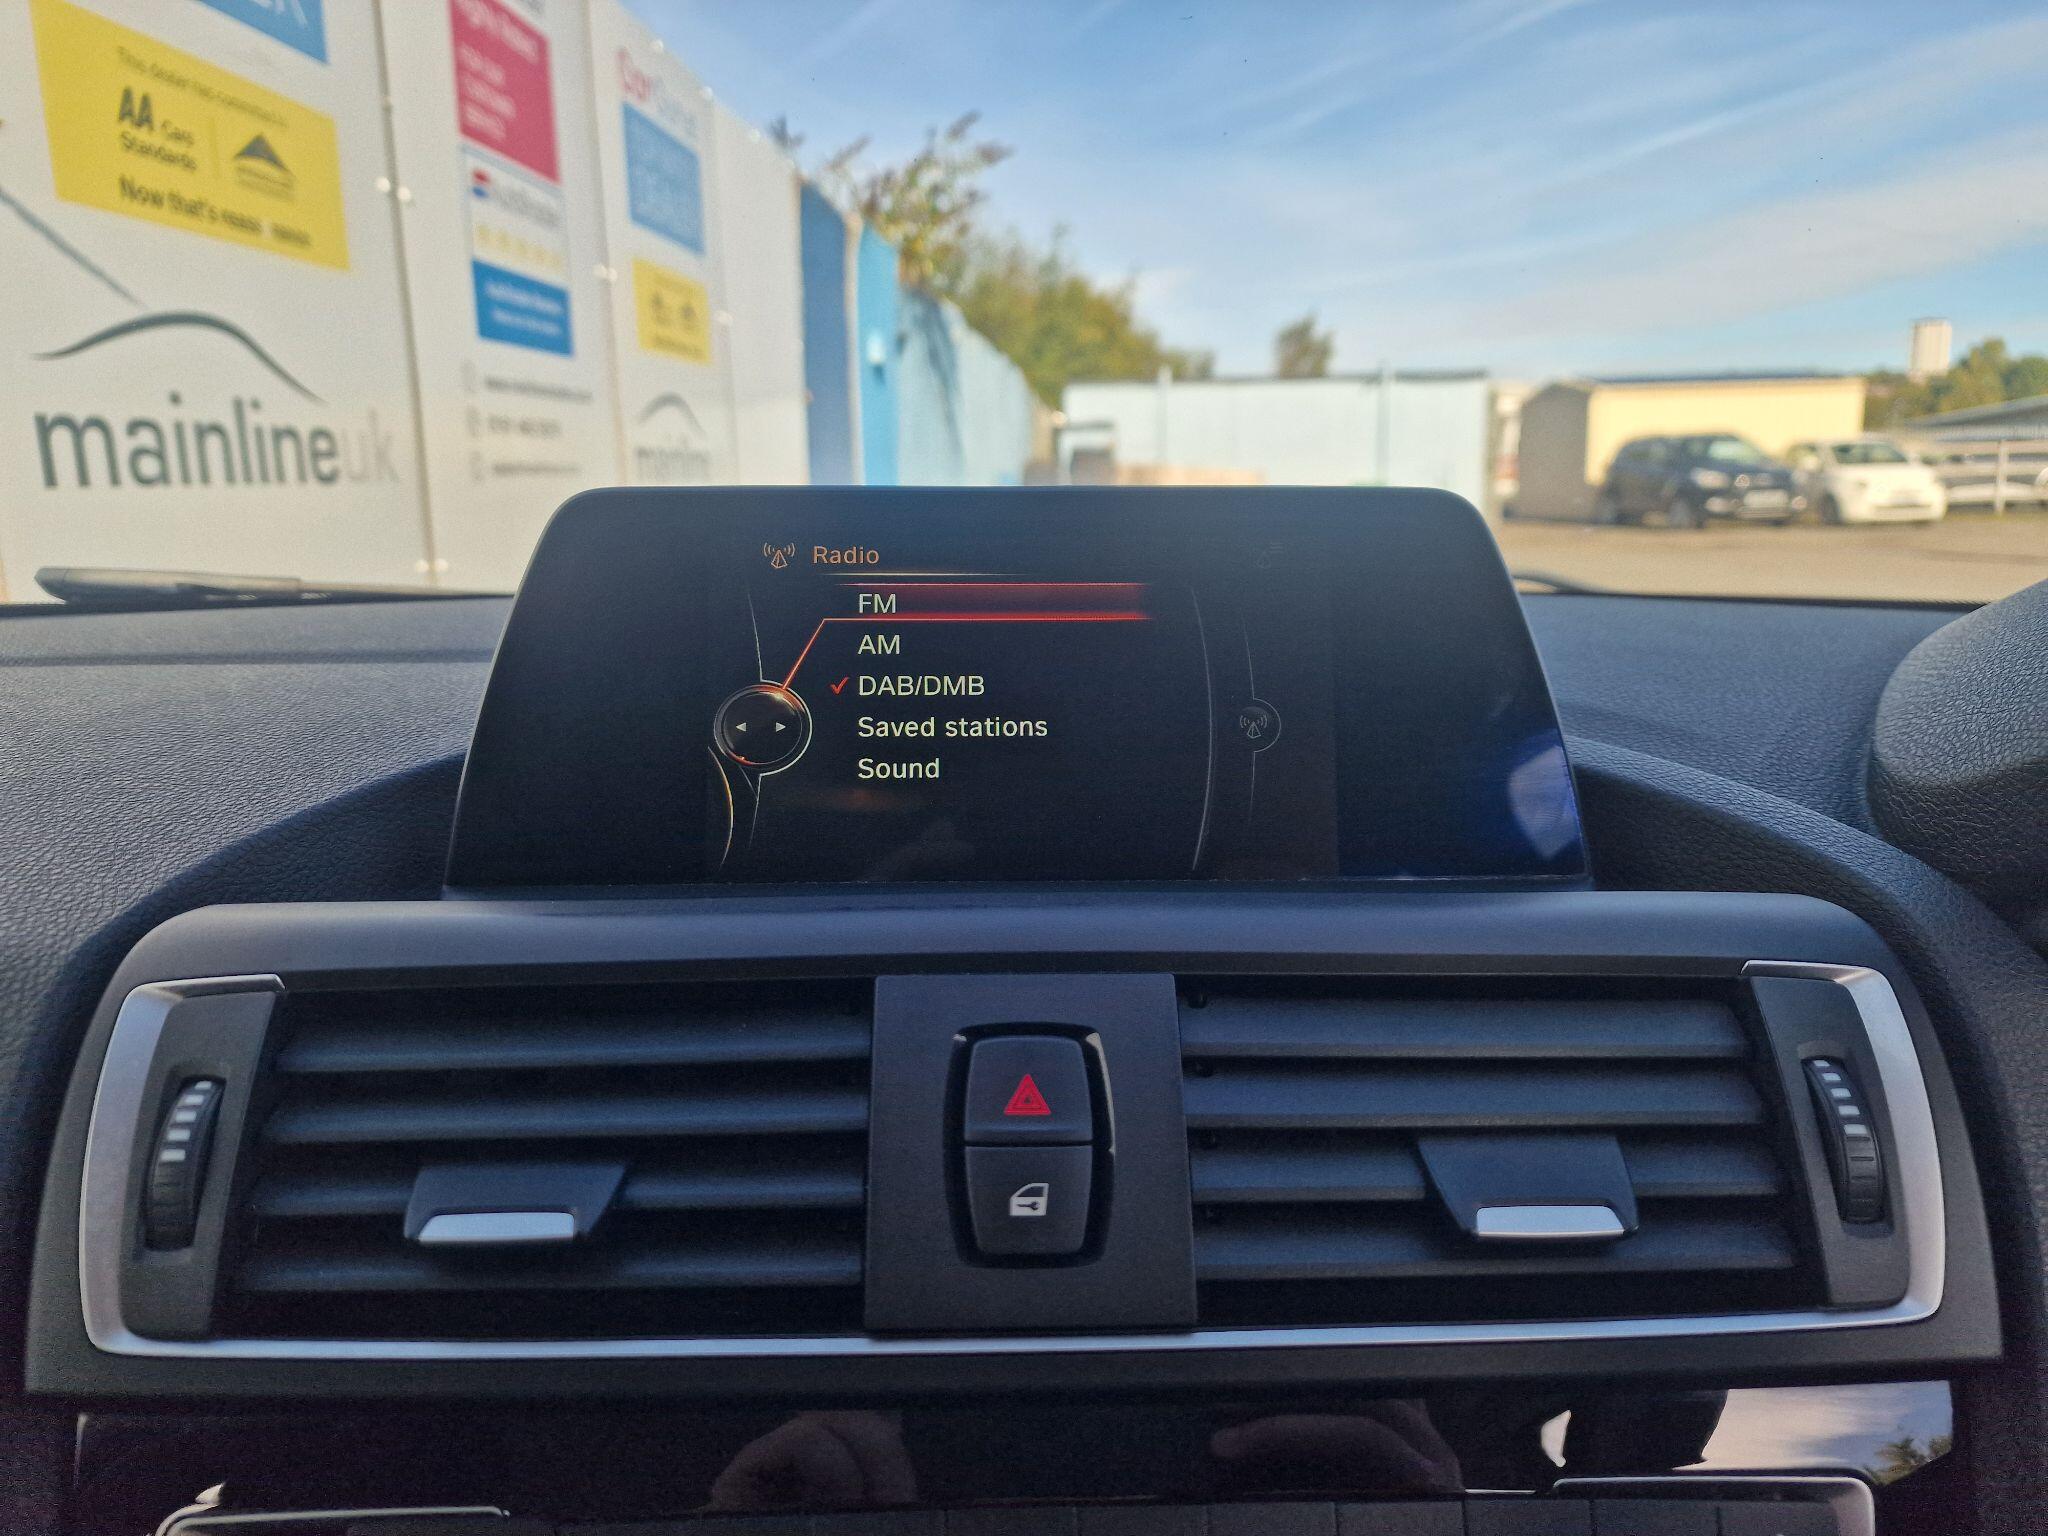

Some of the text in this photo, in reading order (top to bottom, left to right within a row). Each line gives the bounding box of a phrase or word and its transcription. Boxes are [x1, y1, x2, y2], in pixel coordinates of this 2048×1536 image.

[117, 86, 155, 132] AA
[118, 174, 164, 210] Now
[812, 545, 880, 565] Radio
[858, 593, 897, 614] FM
[857, 634, 901, 655] AM
[858, 675, 985, 696] DAB/DMB
[858, 716, 1049, 738] Saved stations
[858, 757, 941, 779] Sound
